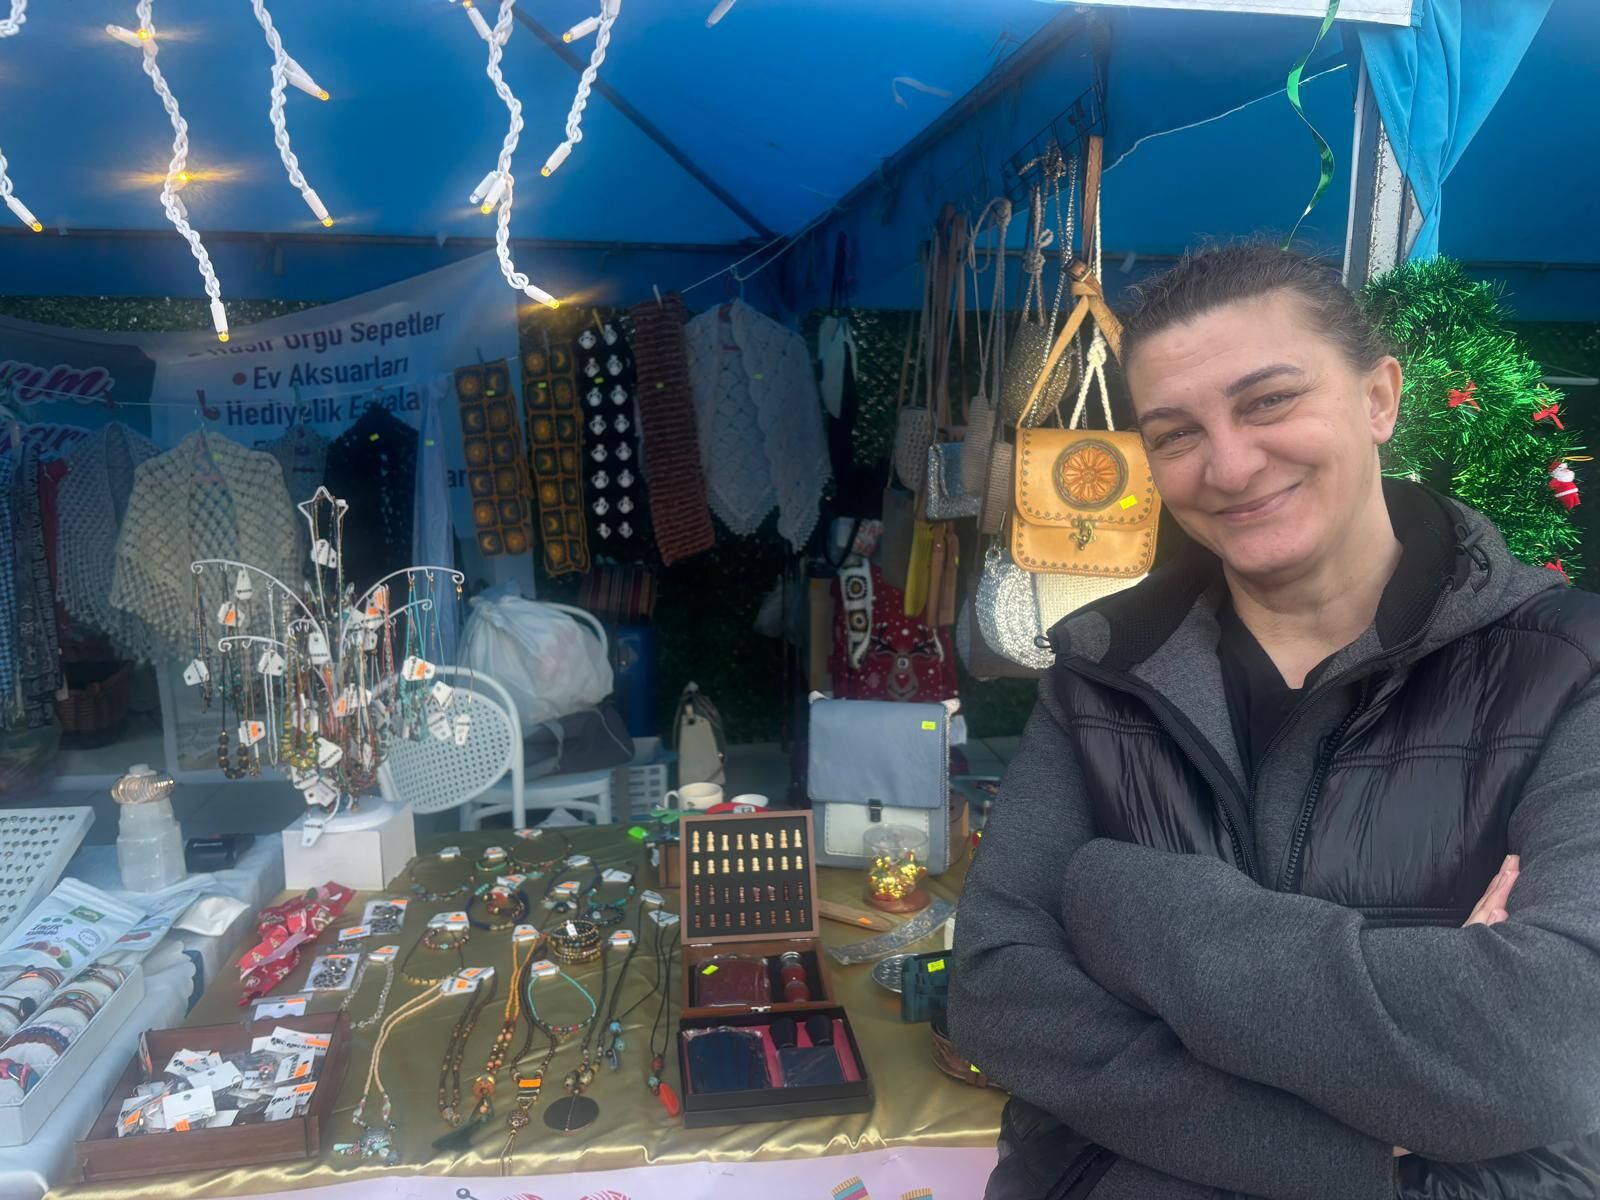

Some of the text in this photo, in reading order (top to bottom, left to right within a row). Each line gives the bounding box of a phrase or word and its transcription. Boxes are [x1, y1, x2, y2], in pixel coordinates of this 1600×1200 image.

[350, 311, 446, 347] Sepetler
[253, 356, 409, 390] Ev Aksuarları
[226, 399, 342, 428] Hediyelik
